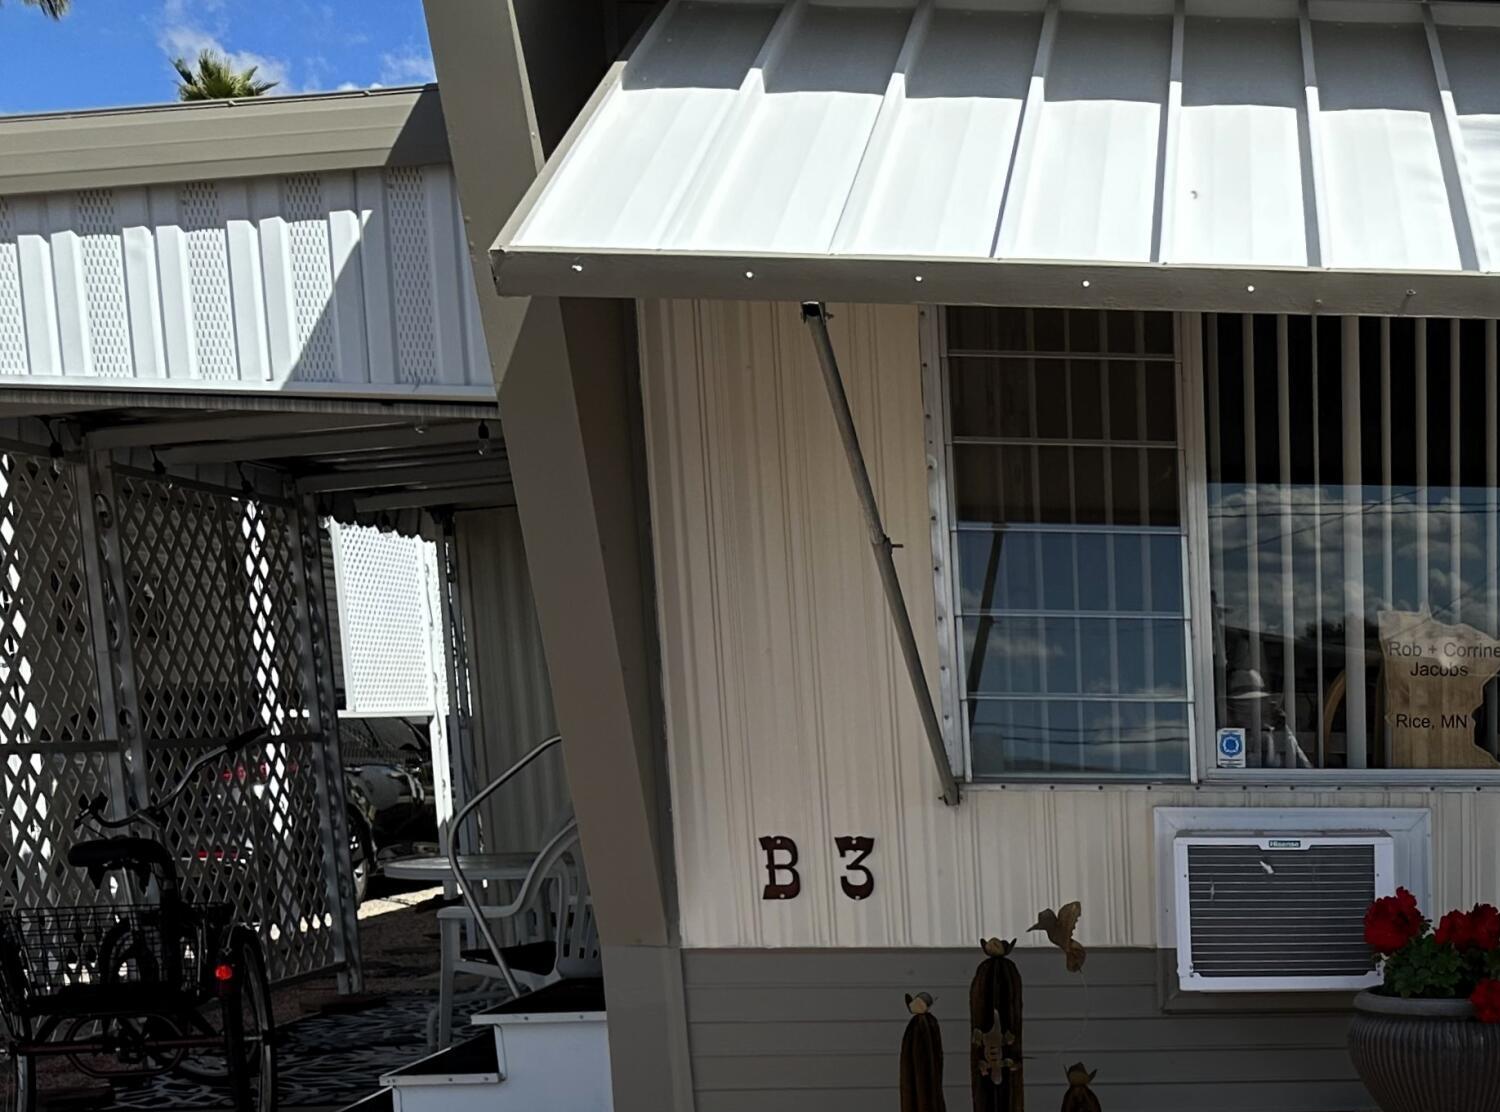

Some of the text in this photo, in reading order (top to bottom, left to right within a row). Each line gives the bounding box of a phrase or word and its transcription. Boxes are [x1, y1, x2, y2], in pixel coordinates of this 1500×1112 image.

[1389, 641, 1422, 656] Rob
[1428, 645, 1438, 654] +
[1410, 661, 1469, 677] Jacobs
[1396, 713, 1468, 730] Rice, MN
